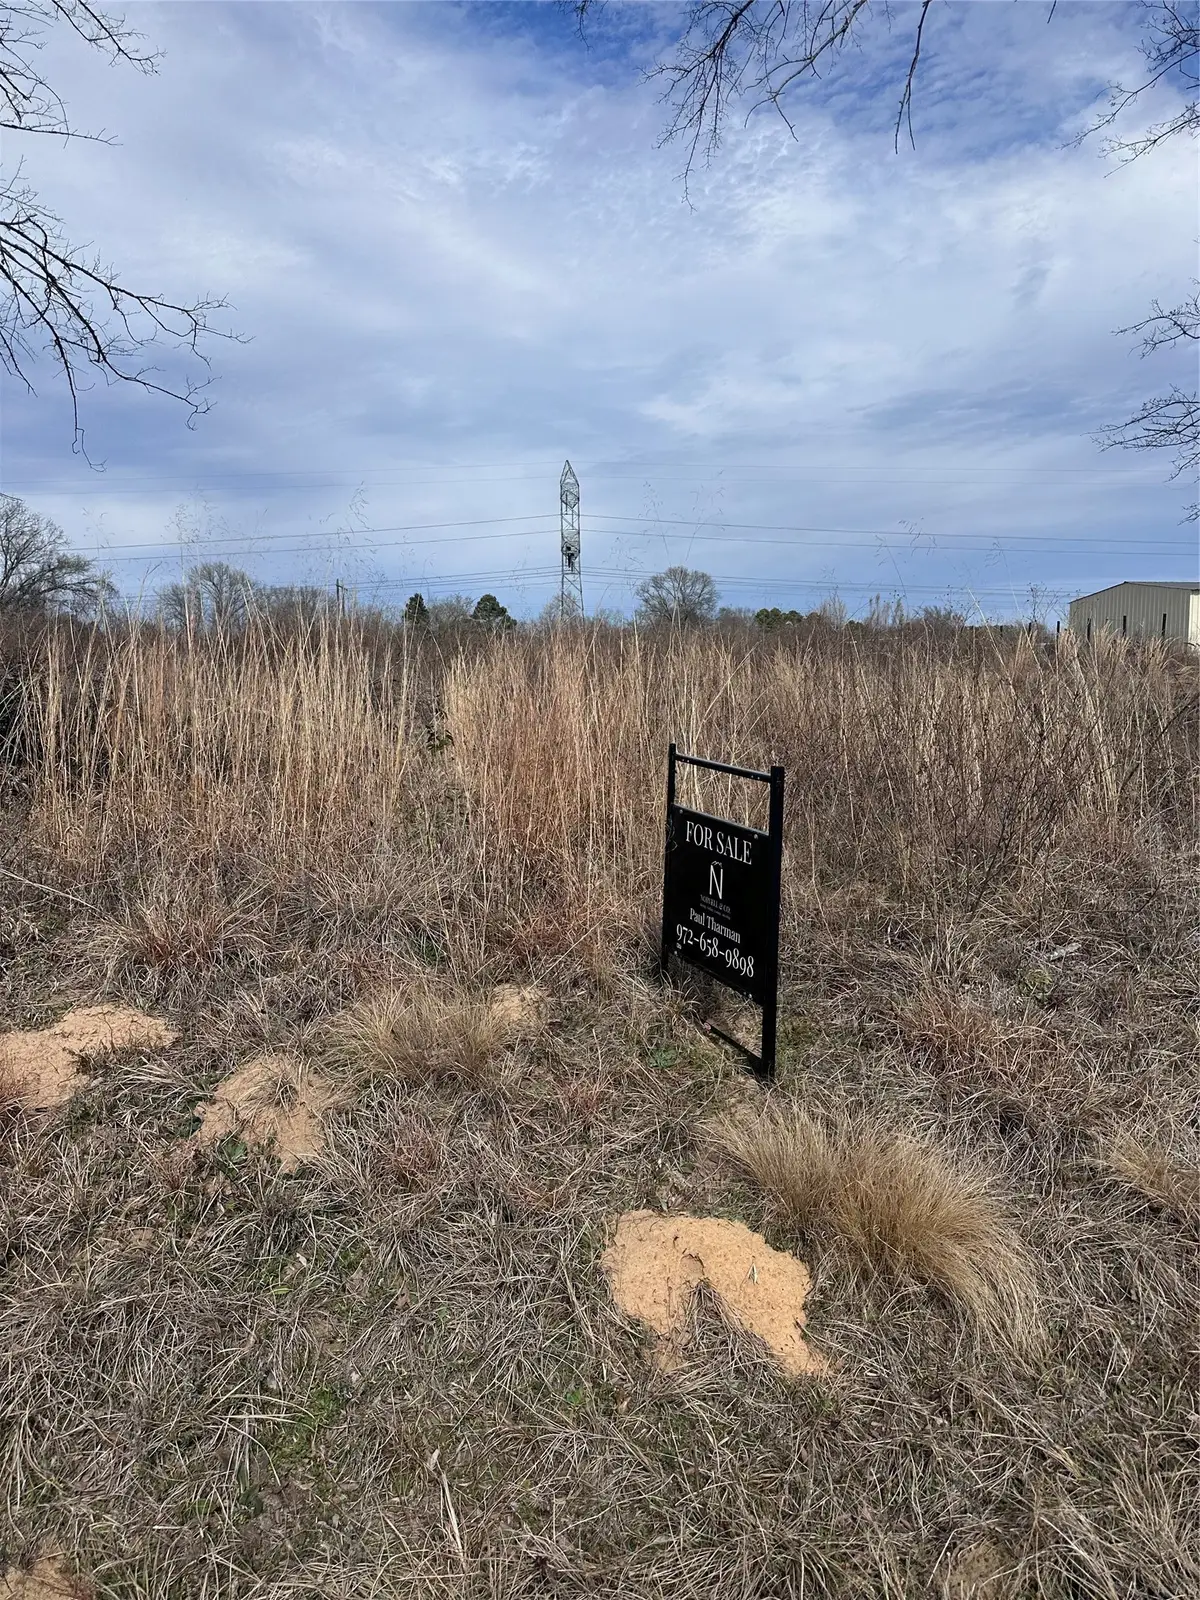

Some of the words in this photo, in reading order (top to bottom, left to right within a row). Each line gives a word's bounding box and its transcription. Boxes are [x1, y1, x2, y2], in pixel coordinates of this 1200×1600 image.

[685, 820, 713, 851] FOR
[716, 831, 752, 865] SALE
[689, 907, 706, 926] Paul
[706, 915, 741, 944] Tharman
[676, 923, 754, 978] 972-658-9898
